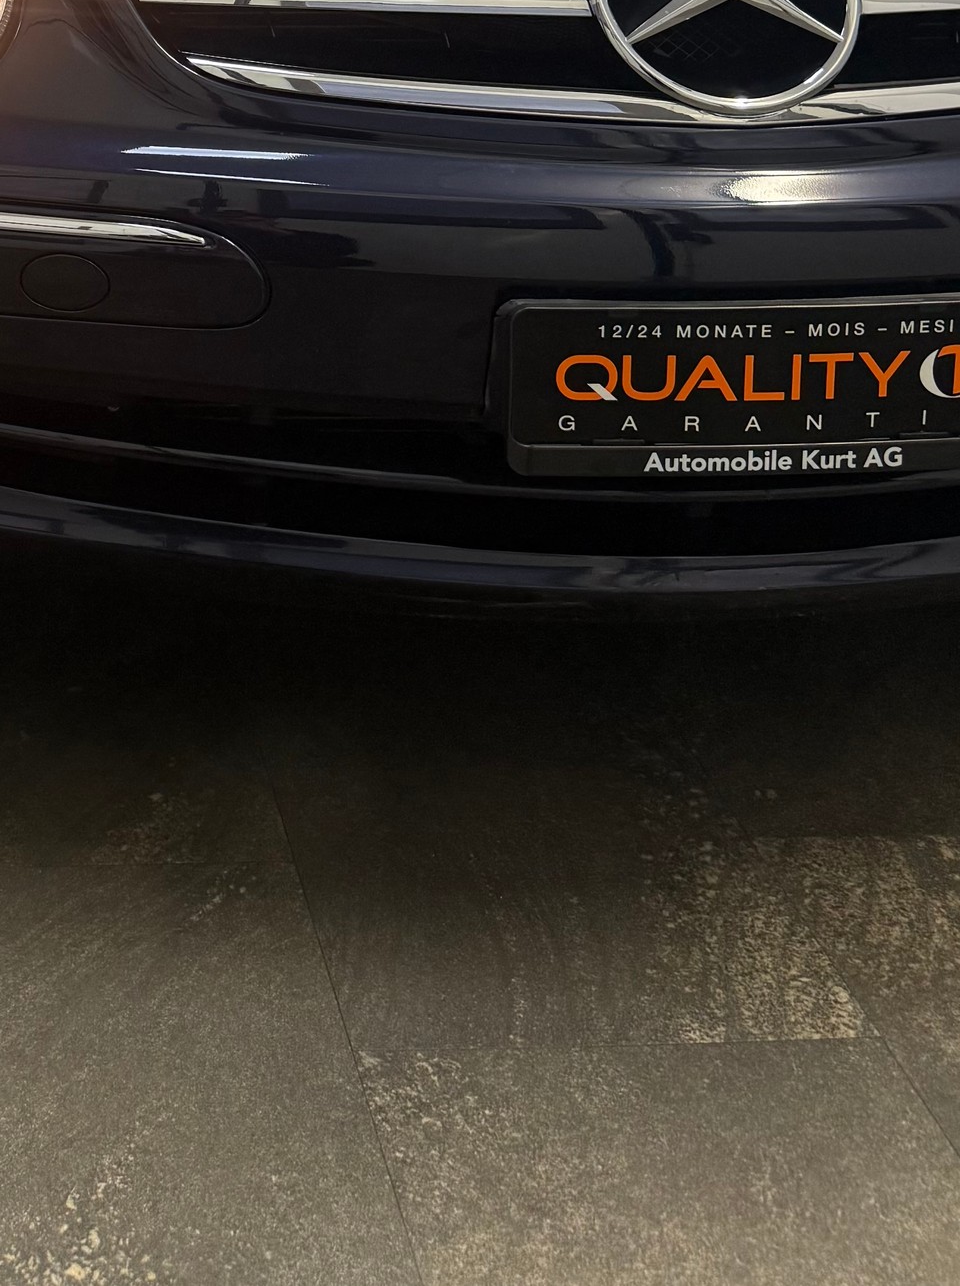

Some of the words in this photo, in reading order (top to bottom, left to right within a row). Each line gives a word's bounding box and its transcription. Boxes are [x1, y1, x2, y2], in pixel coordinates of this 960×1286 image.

[598, 324, 662, 339] 12/24
[676, 324, 773, 339] MONATE
[808, 322, 866, 337] MOIS
[900, 319, 954, 334] MESI
[555, 350, 911, 402] QUALITY
[644, 451, 792, 473] Automobile
[801, 449, 856, 471] Kurt
[863, 447, 904, 468] AG
